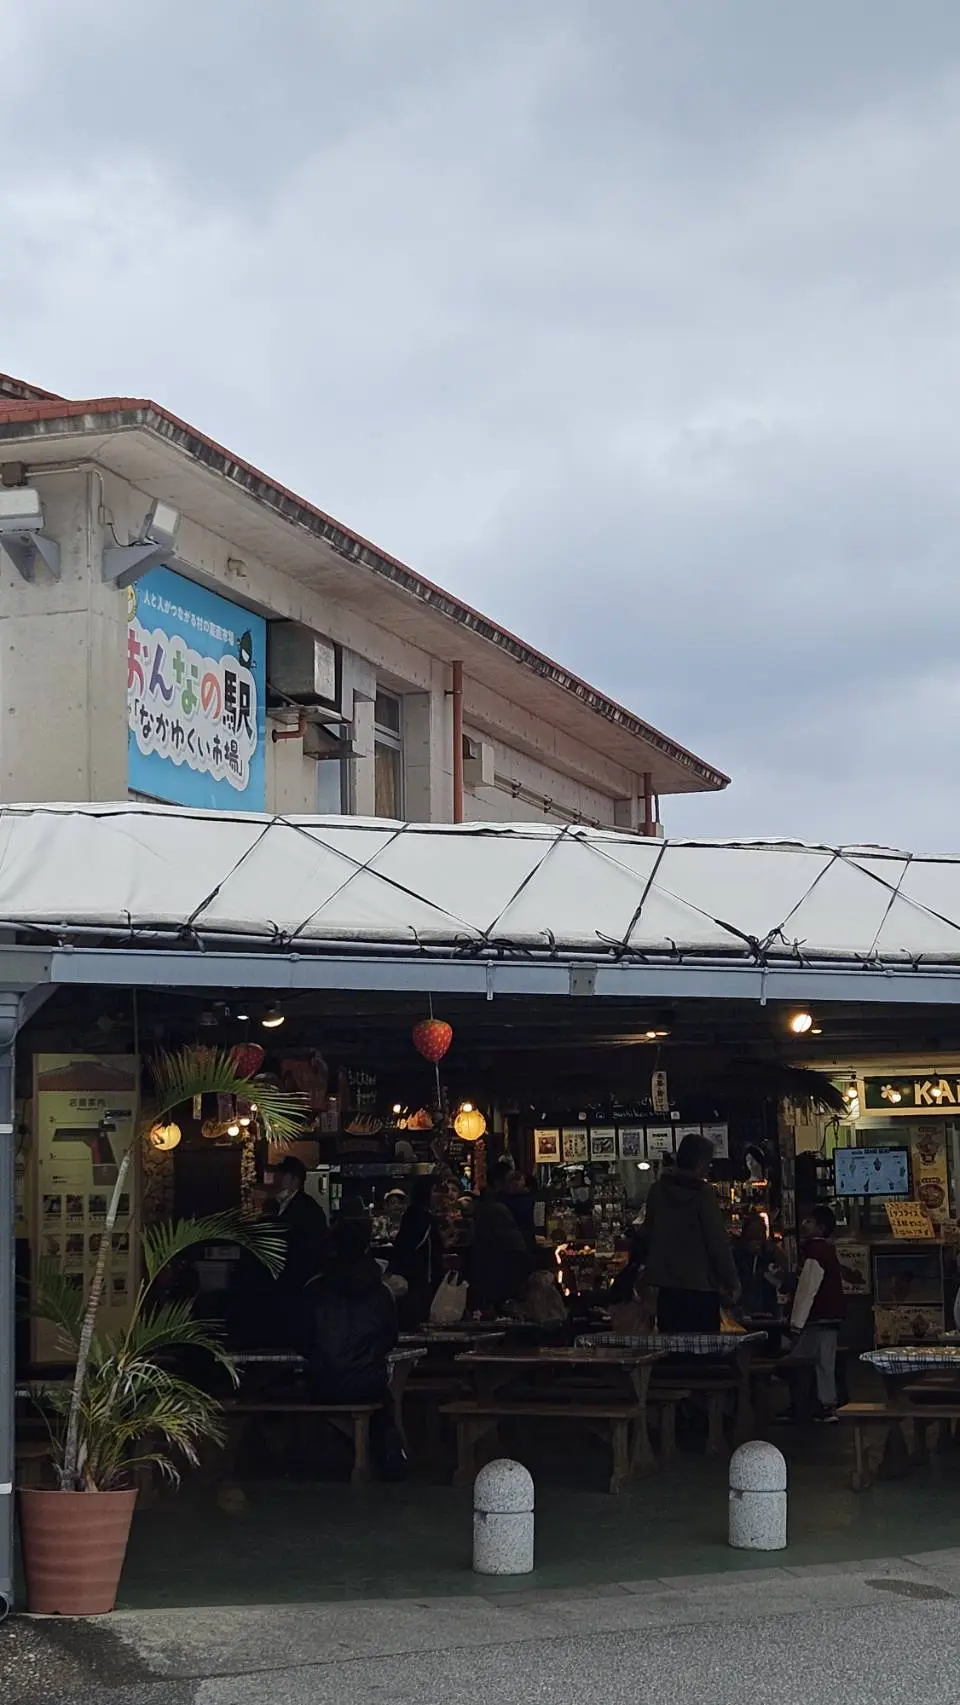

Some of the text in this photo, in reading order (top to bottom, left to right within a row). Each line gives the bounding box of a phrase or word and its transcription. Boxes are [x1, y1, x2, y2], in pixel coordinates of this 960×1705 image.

[128, 628, 253, 739] おんなの駅
[914, 1079, 960, 1105] KA
